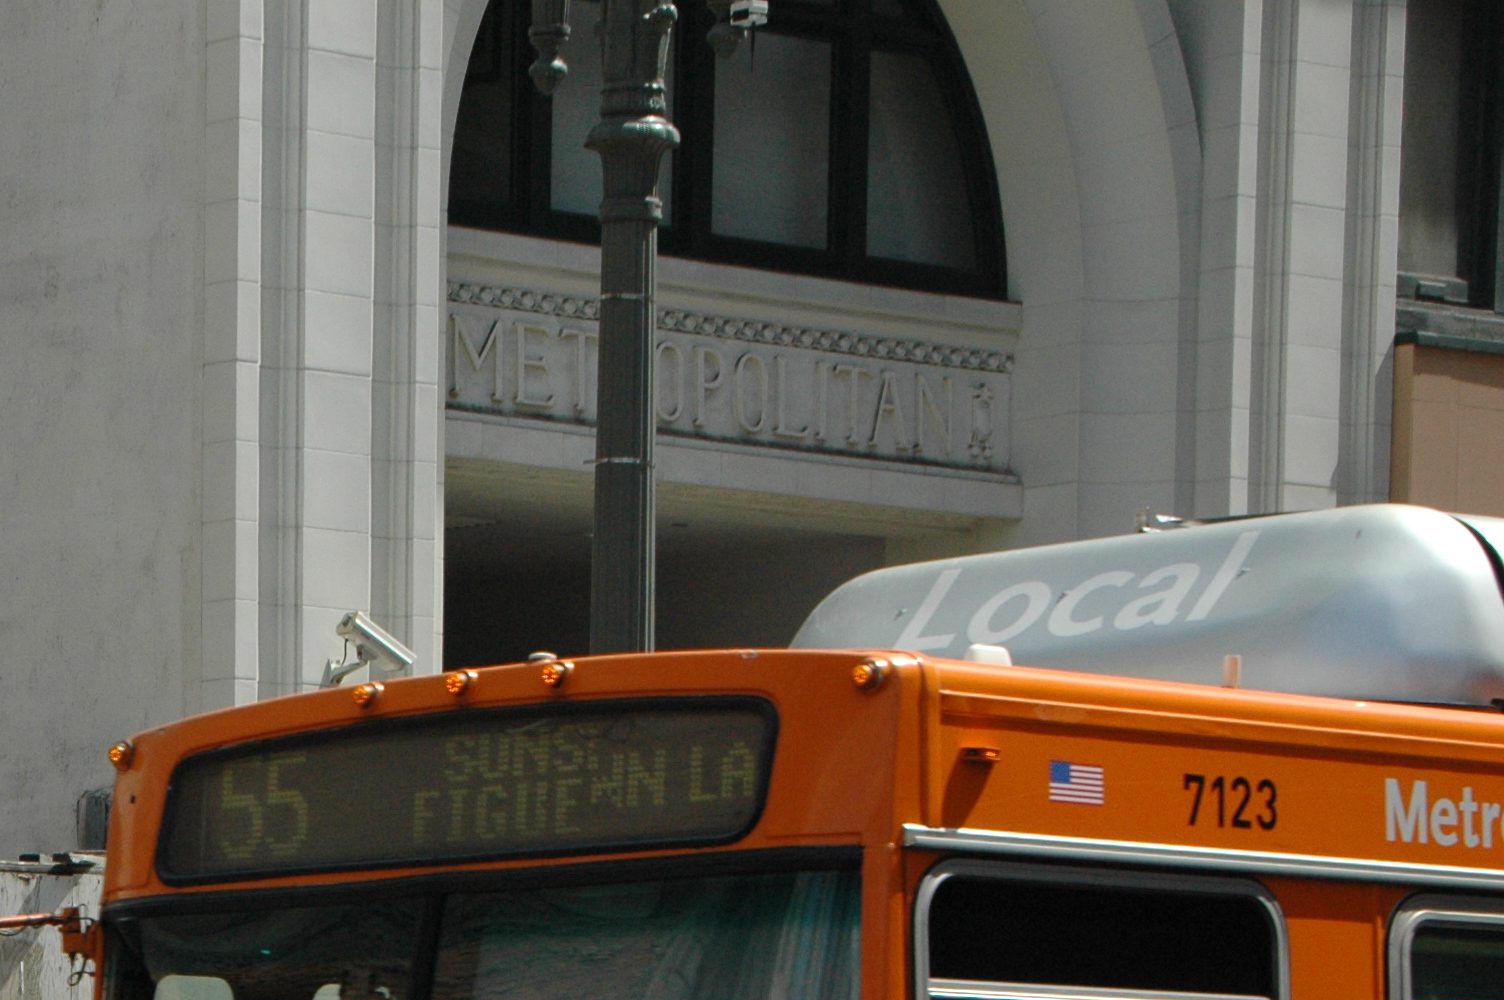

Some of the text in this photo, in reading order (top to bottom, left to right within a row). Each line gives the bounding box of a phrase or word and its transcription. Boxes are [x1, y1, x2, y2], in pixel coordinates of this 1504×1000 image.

[447, 312, 955, 455] METOPOLITAN
[897, 531, 1260, 650] Local
[220, 751, 308, 861] 55
[689, 738, 756, 802] LA
[1183, 773, 1277, 831] 7123
[1384, 777, 1504, 850] Metr
